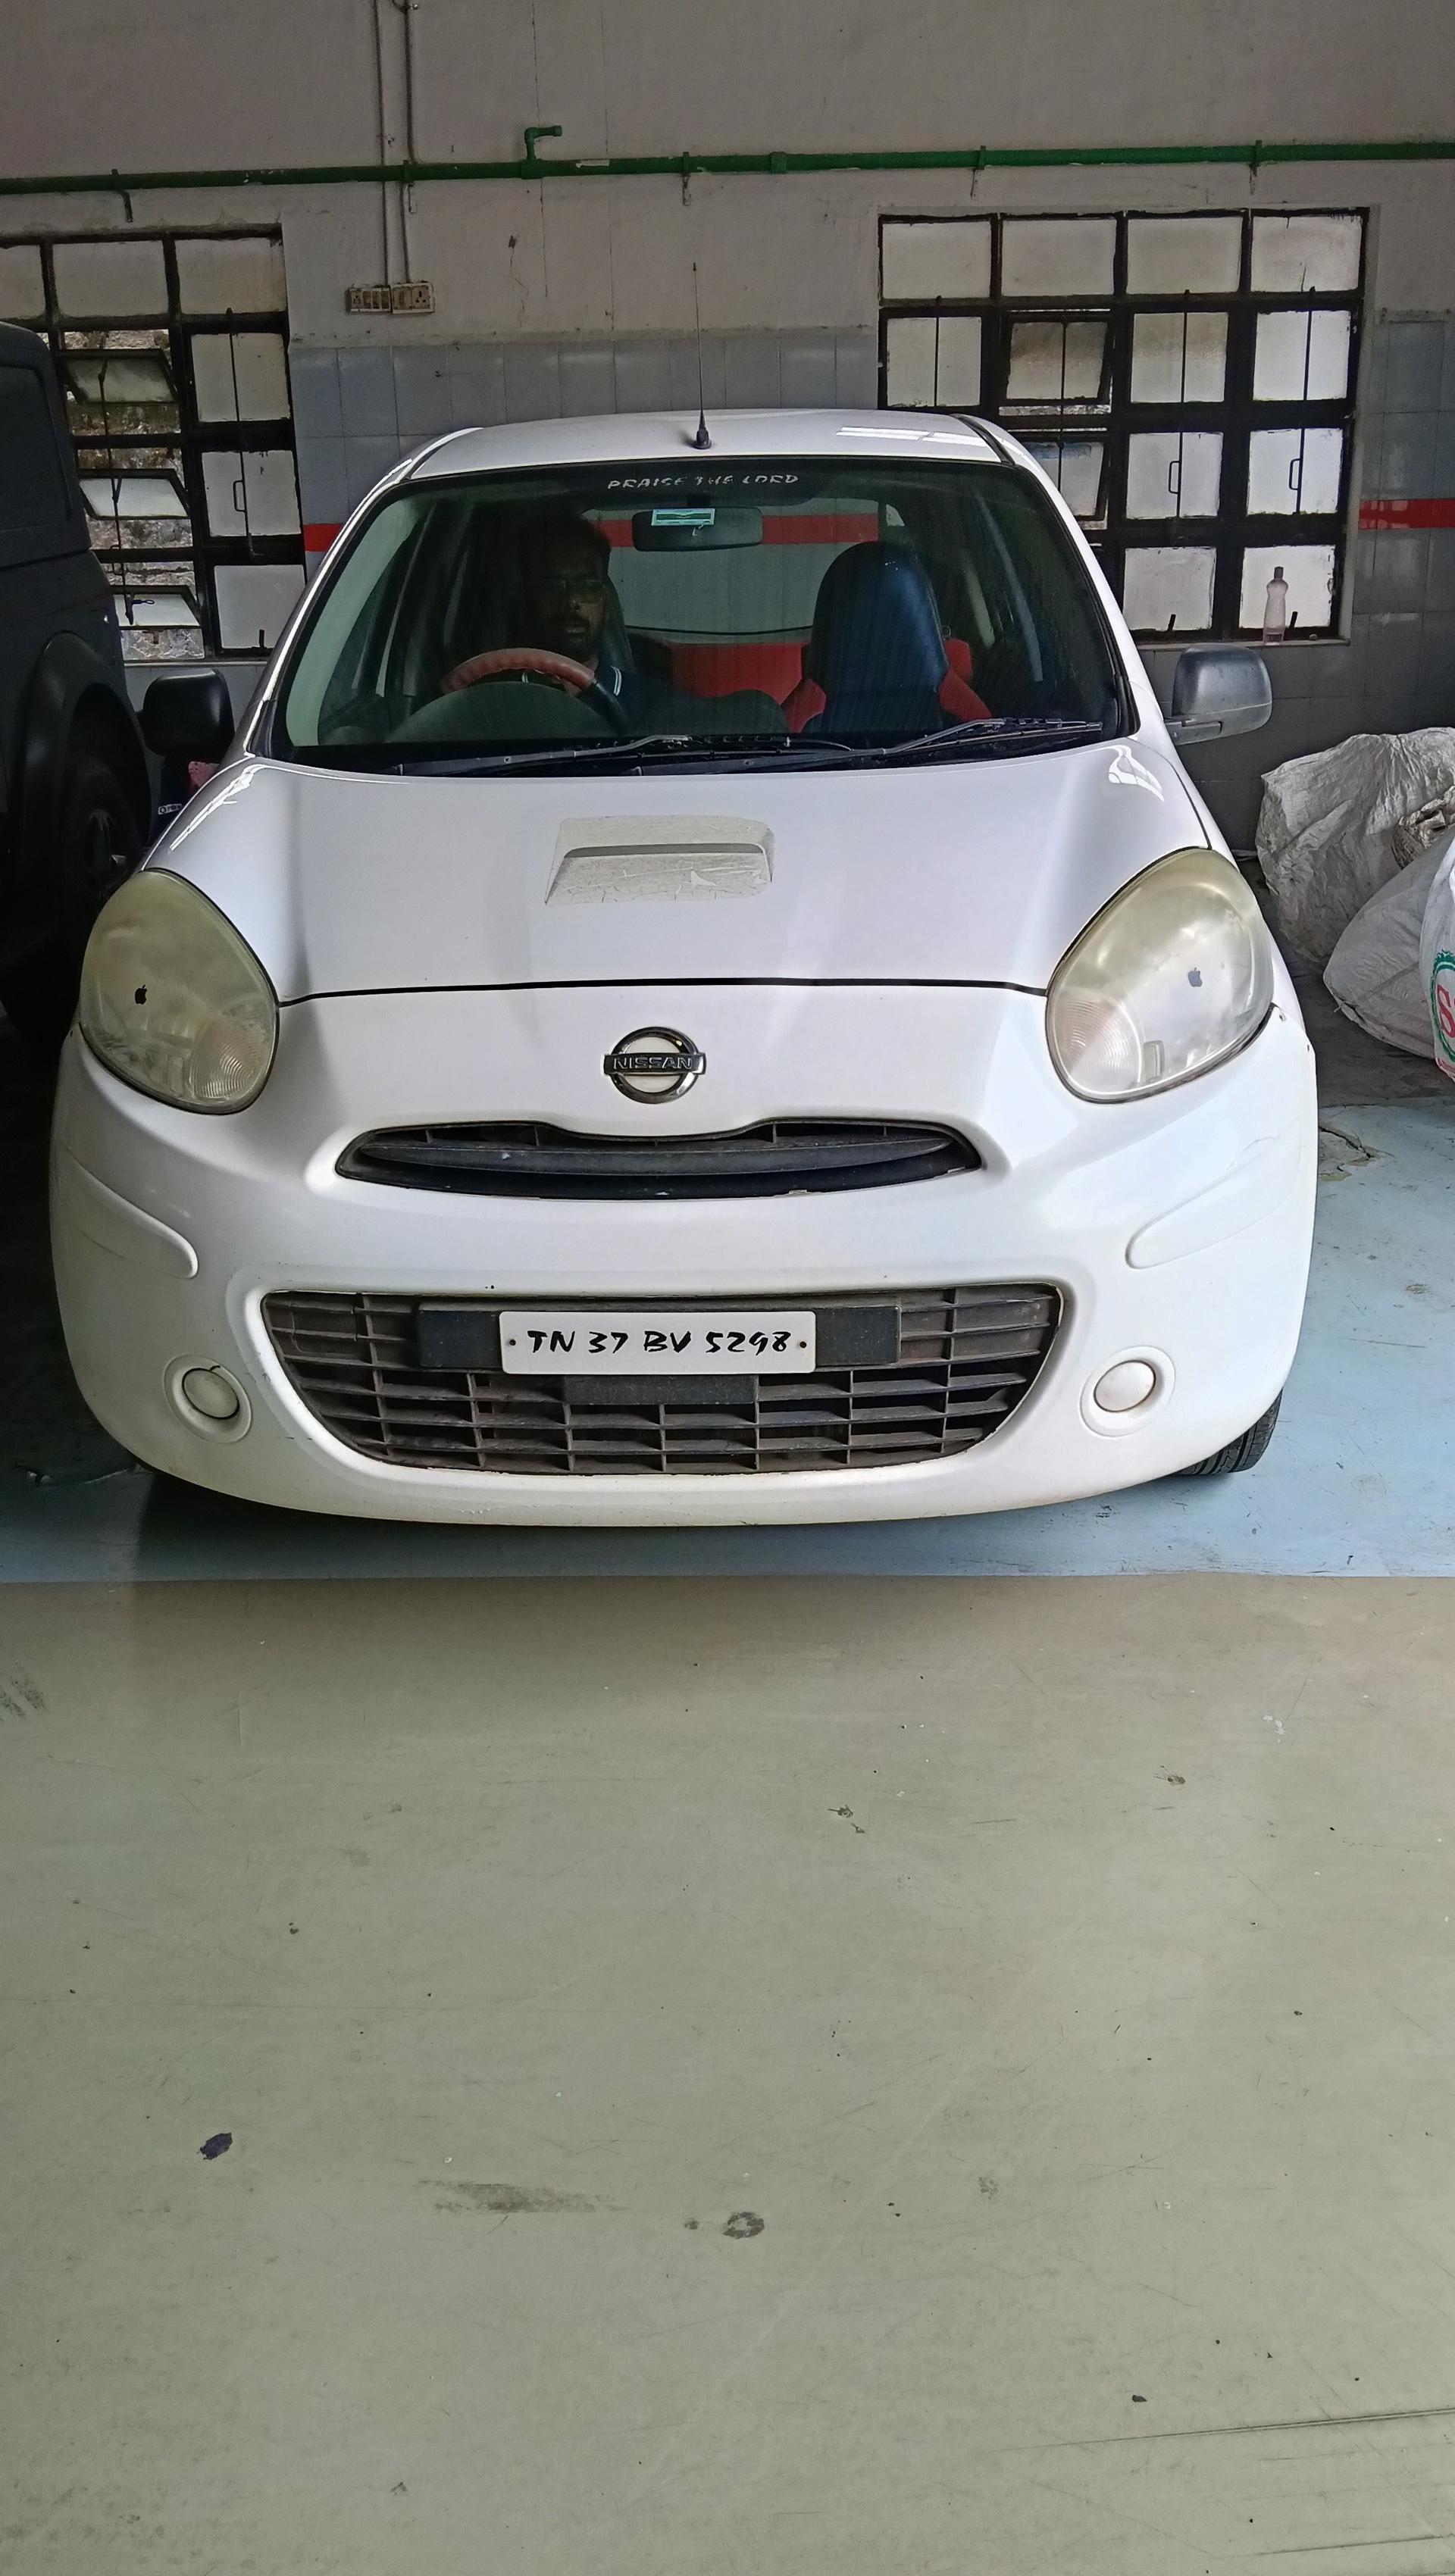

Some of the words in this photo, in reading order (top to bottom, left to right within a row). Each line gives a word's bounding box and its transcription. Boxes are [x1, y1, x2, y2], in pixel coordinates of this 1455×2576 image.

[607, 477, 687, 489] PRAISE
[613, 1057, 693, 1070] NISSAN
[527, 1330, 576, 1353] TN
[588, 1330, 628, 1354] 37
[643, 1330, 692, 1353] BV
[705, 1331, 792, 1356] 5298
